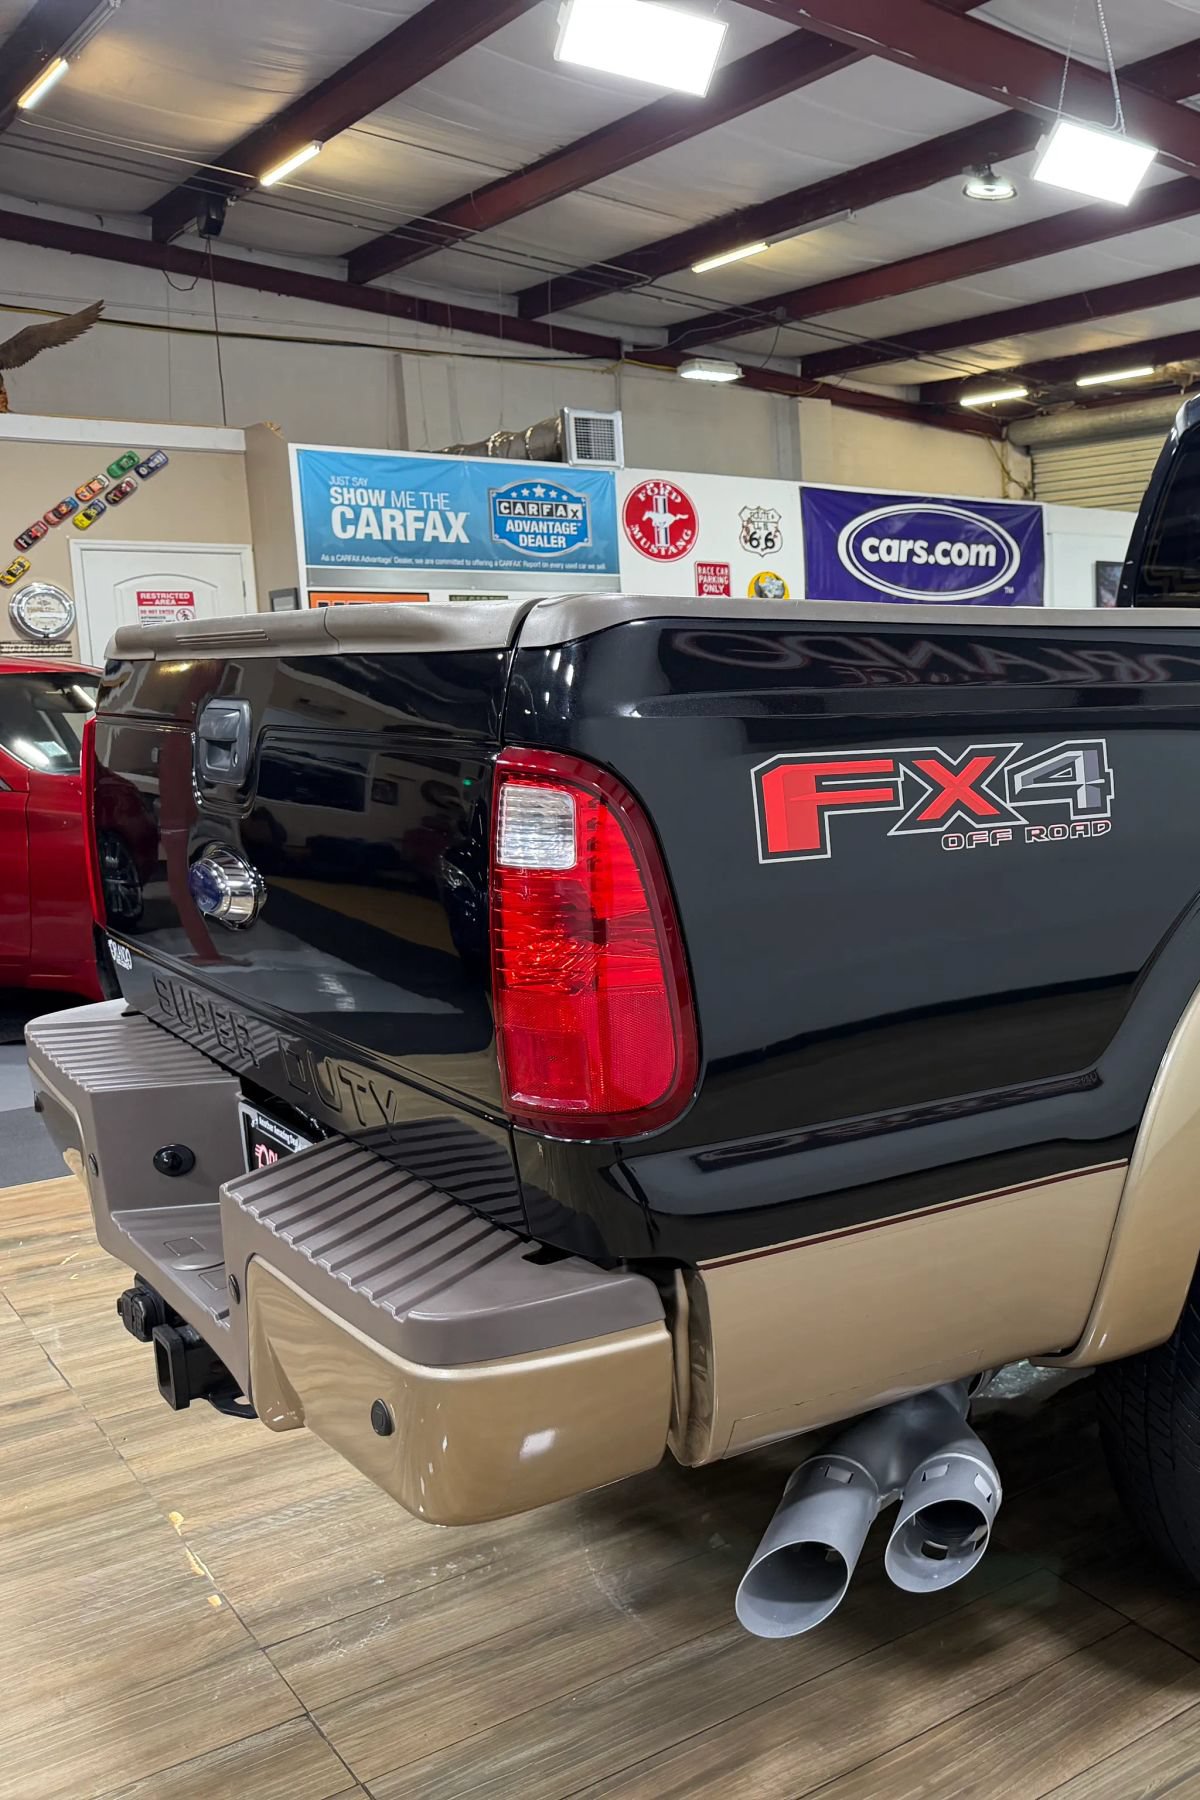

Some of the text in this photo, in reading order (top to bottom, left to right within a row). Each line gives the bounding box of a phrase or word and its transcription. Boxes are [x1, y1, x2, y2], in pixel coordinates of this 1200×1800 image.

[329, 476, 368, 487] JUST SAY
[330, 486, 451, 510] SHOW ME THE
[637, 482, 682, 503] FORD
[499, 501, 580, 519] CARFAX
[331, 506, 470, 543] CARFAX
[506, 519, 578, 535] ADVANTAGE
[519, 534, 567, 548] DEALER
[630, 524, 692, 556] MUSTANG
[749, 531, 775, 550] 66
[861, 537, 997, 567] cars.com
[321, 554, 330, 562] As
[472, 559, 493, 568] offering
[523, 560, 541, 569] Report
[550, 562, 564, 570] every
[565, 561, 577, 569] used
[698, 566, 729, 576] RACE CAR
[698, 575, 729, 585] PARKING
[703, 584, 725, 594] ONLY
[1004, 586, 1014, 594] TM
[750, 739, 1115, 864] FX4
[941, 819, 1112, 851] OFF ROAD
[152, 975, 260, 1069] SUPER
[277, 1032, 398, 1143] DUTY
